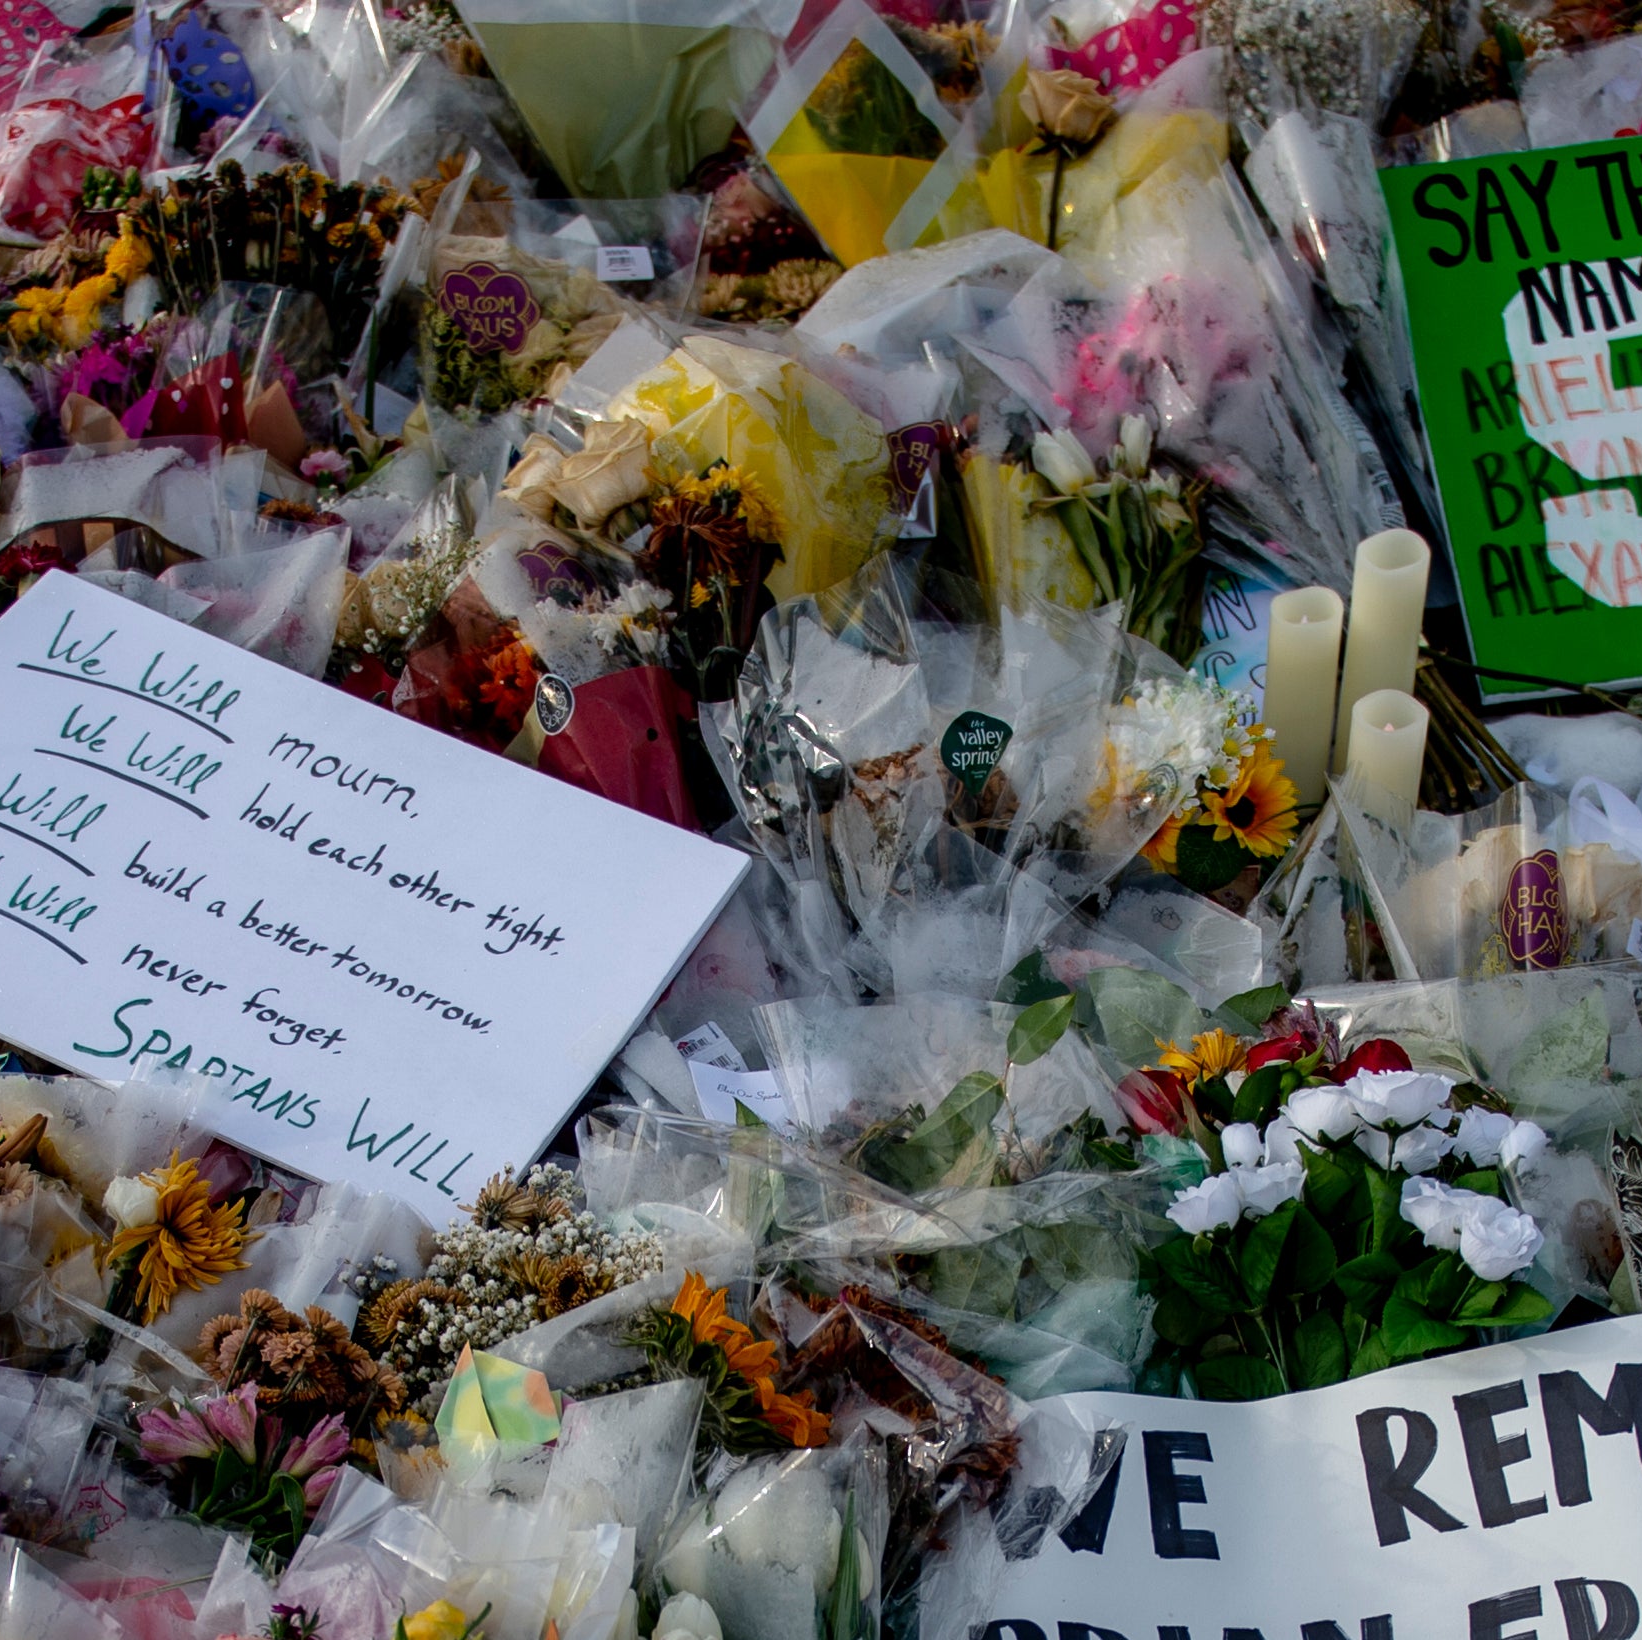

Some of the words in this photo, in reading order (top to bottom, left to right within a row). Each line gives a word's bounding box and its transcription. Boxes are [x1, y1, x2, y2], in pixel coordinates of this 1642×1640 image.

[1413, 160, 1560, 267] SAY
[453, 292, 516, 315] BLOOM
[47, 610, 118, 676] We
[139, 652, 242, 724] Will
[958, 728, 1004, 749] valley
[971, 720, 985, 728] the
[60, 704, 124, 753] We
[127, 732, 223, 795] Will
[240, 783, 312, 842] hold
[307, 844, 385, 877] each
[389, 870, 475, 914] other
[9, 875, 97, 933] Will
[121, 944, 228, 997] never
[124, 841, 193, 903] build
[206, 899, 227, 919] a
[239, 899, 328, 958] better
